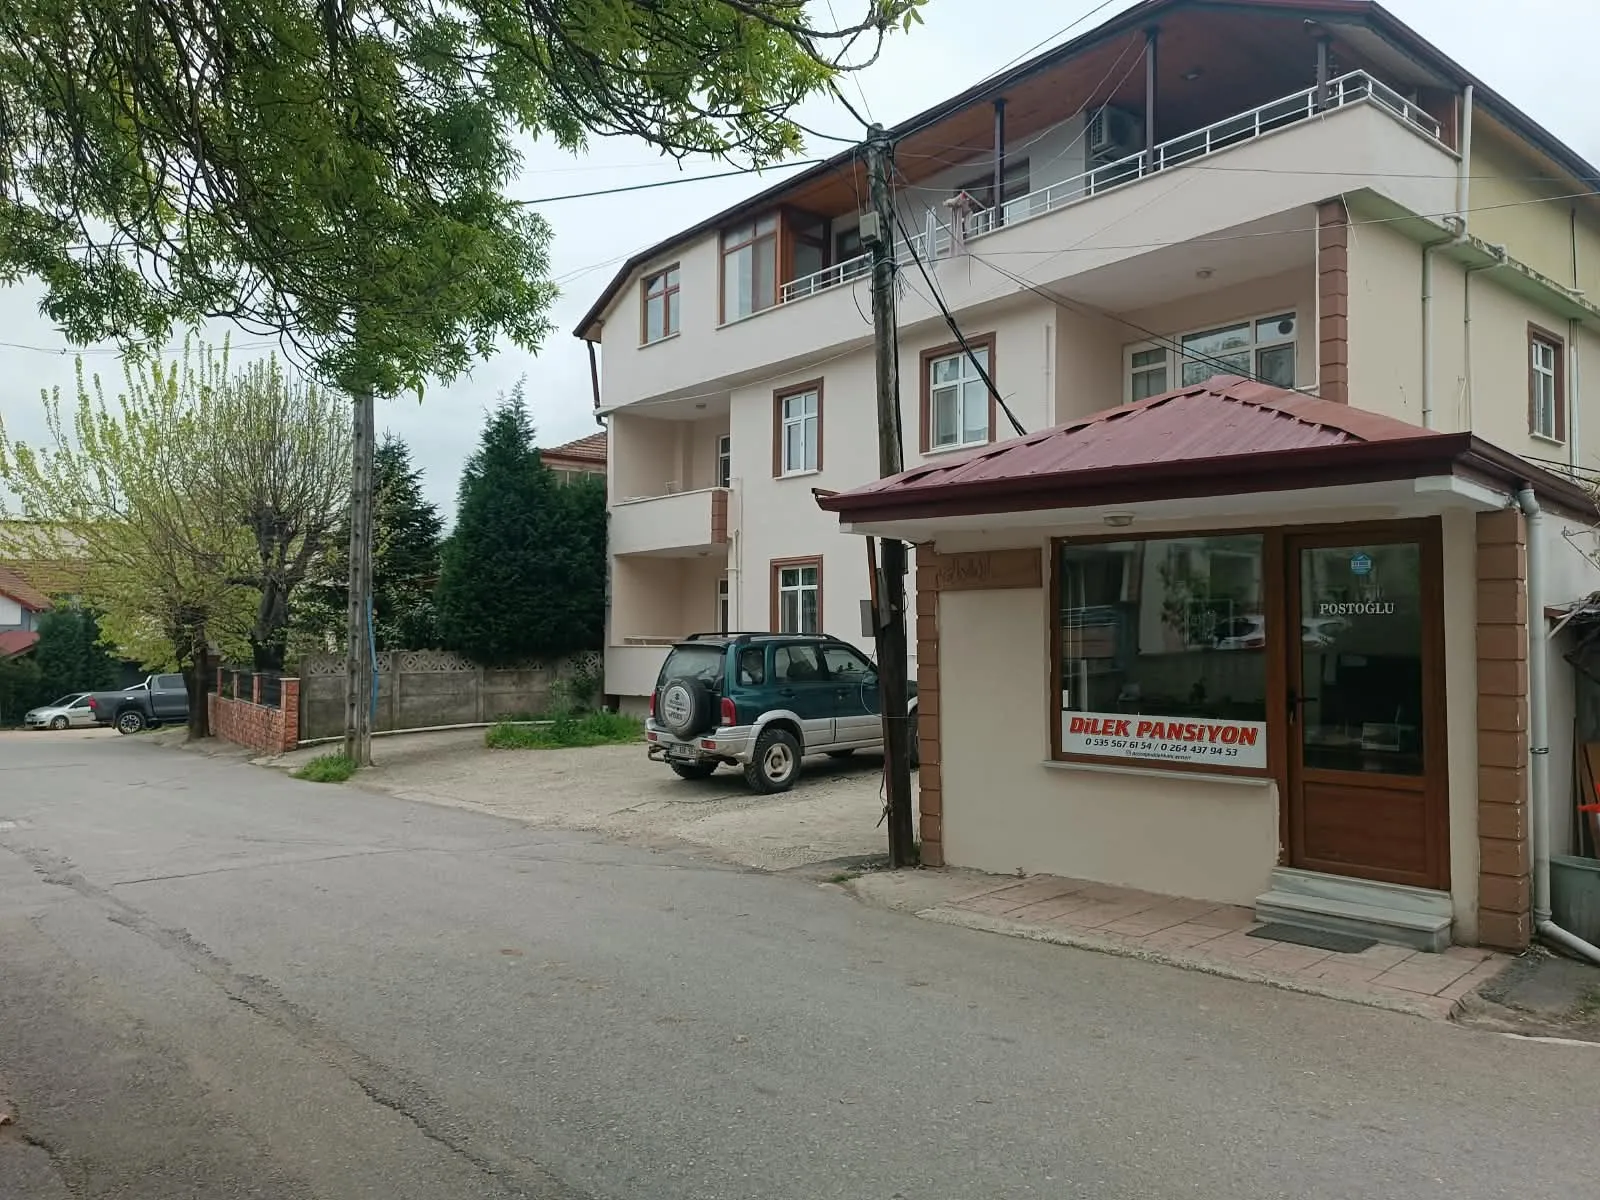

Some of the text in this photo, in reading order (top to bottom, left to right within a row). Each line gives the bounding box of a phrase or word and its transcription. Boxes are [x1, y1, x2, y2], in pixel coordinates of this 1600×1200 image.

[1319, 601, 1394, 614] POSTOĞLU
[1085, 738, 1092, 746] 0
[1093, 738, 1109, 747] 535
[1111, 739, 1127, 748] 567
[1129, 741, 1138, 749] 61
[1140, 742, 1152, 750] 54
[1160, 743, 1168, 751] 0
[1169, 744, 1187, 752] 264
[1190, 745, 1208, 754] 437
[1210, 747, 1222, 755] 94
[1225, 748, 1238, 757] 53
